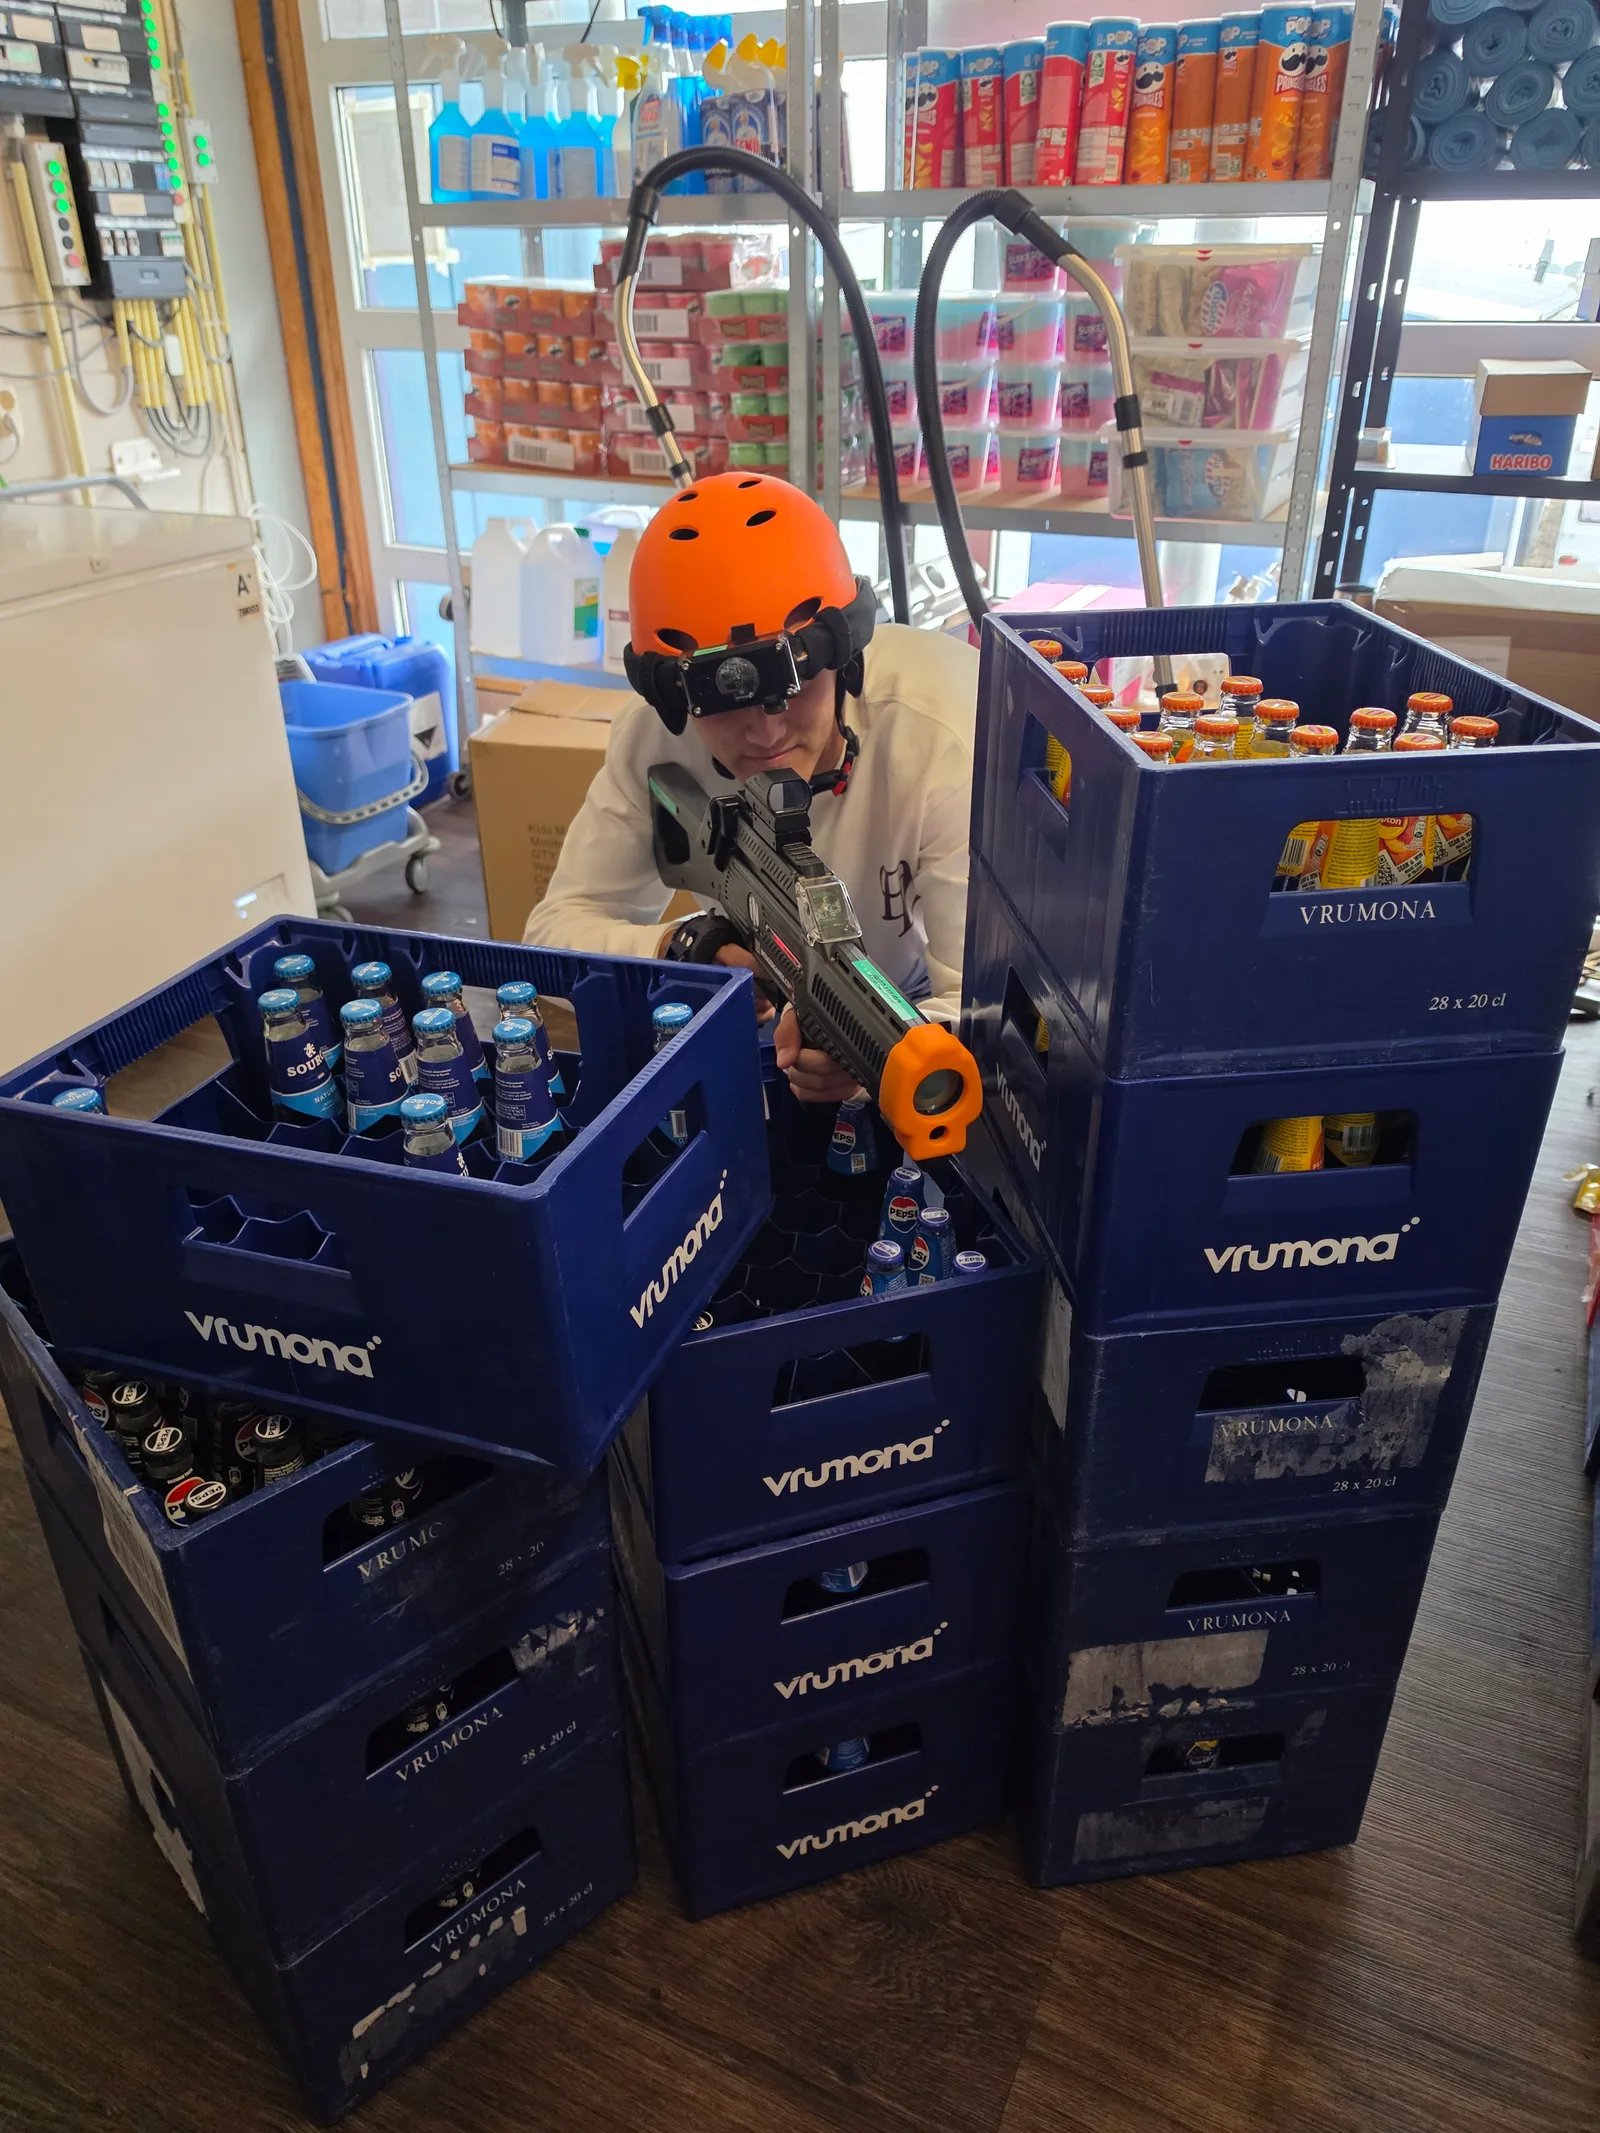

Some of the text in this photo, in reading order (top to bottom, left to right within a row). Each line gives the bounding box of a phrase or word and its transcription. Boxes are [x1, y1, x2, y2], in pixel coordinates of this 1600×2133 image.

[1490, 454, 1553, 471] HARIBO
[1380, 816, 1402, 826] pton
[1300, 900, 1437, 925] VRUMONA
[1428, 992, 1507, 1011] 28 x 20 cl
[287, 1054, 324, 1078] SOUR
[996, 1062, 1041, 1172] vrumona
[833, 1131, 855, 1145] EPSI
[890, 1207, 918, 1219] PEPSI
[630, 1190, 724, 1330] vrumona
[911, 1249, 928, 1263] PSI
[959, 1255, 985, 1263] PEPSI
[1204, 1232, 1400, 1274] vrumona
[184, 1311, 375, 1379] vrumona
[1220, 1414, 1333, 1438] VRUMONA
[155, 1428, 172, 1450] PEPSI
[763, 1433, 935, 1497] vrumona
[191, 1485, 223, 1504] PEPSI
[1332, 1481, 1349, 1492] 28
[1352, 1481, 1360, 1490] x
[1365, 1478, 1381, 1489] 20
[1187, 1609, 1292, 1632] VRUMONA
[773, 1635, 934, 1699] vrumona
[1291, 1664, 1307, 1677] 28
[1321, 1661, 1337, 1673] 20
[395, 1707, 504, 1782] VRUMONA
[776, 1791, 928, 1859] vrumona
[430, 1879, 527, 1953] VRUMONA
